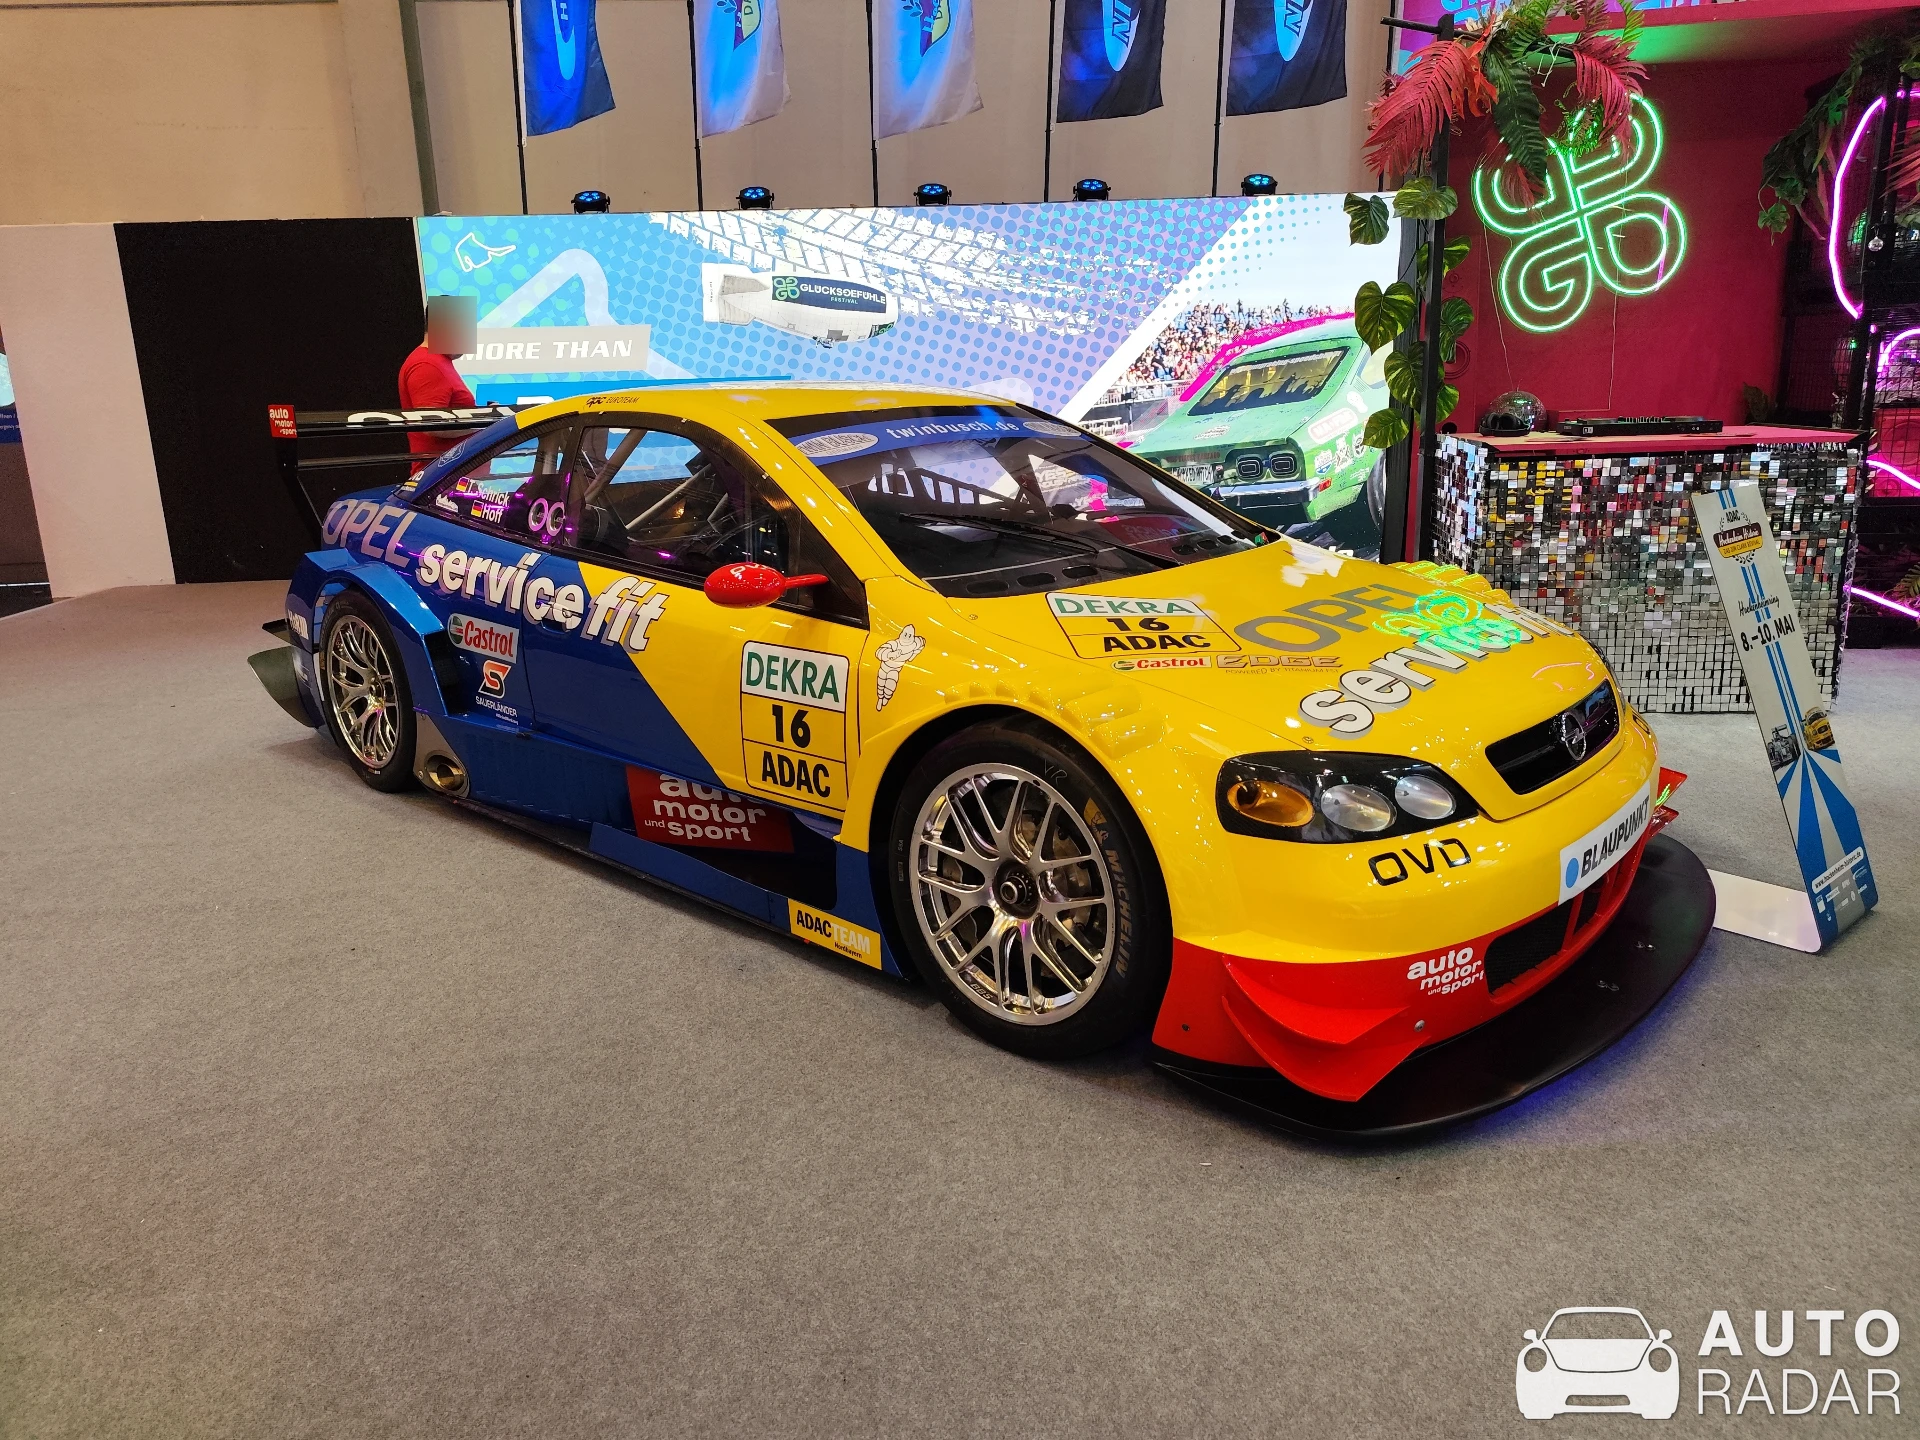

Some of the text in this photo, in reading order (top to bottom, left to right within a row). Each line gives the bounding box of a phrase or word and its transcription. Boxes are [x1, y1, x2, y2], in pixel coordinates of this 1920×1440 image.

[830, 297, 859, 305] FESTIVAL
[553, 340, 632, 359] THAN
[269, 408, 289, 419] auto
[274, 419, 294, 428] motor
[886, 420, 1020, 439] twinbusch.de
[478, 484, 510, 508] Schrick
[481, 506, 504, 524] Hoff
[1725, 509, 1741, 523] ADAC
[322, 499, 418, 569] OPEL
[417, 543, 670, 653] service fit
[1054, 598, 1196, 614] DEKRA
[1106, 617, 1170, 632] 16
[1774, 613, 1796, 639] MAI
[464, 620, 515, 658] Castrol
[1104, 634, 1211, 652] ADAC
[1136, 654, 1344, 669] Castrol EDGE
[1225, 667, 1268, 675] POWERED
[745, 651, 840, 703] DEKRA
[475, 695, 518, 718] SAUERLÄNDER
[771, 703, 811, 749] 16
[761, 751, 831, 798] ADAC
[653, 799, 766, 825] motor
[644, 819, 752, 842] und sport
[1581, 794, 1650, 879] BLAUPUNKT
[1368, 837, 1472, 887] OVD
[1105, 849, 1133, 979] MICHELIN
[834, 941, 863, 959] Nordbayern
[1407, 946, 1474, 980] auto
[1419, 959, 1482, 990] motor
[970, 982, 994, 1000] BBS
[1427, 970, 1485, 996] und sport
